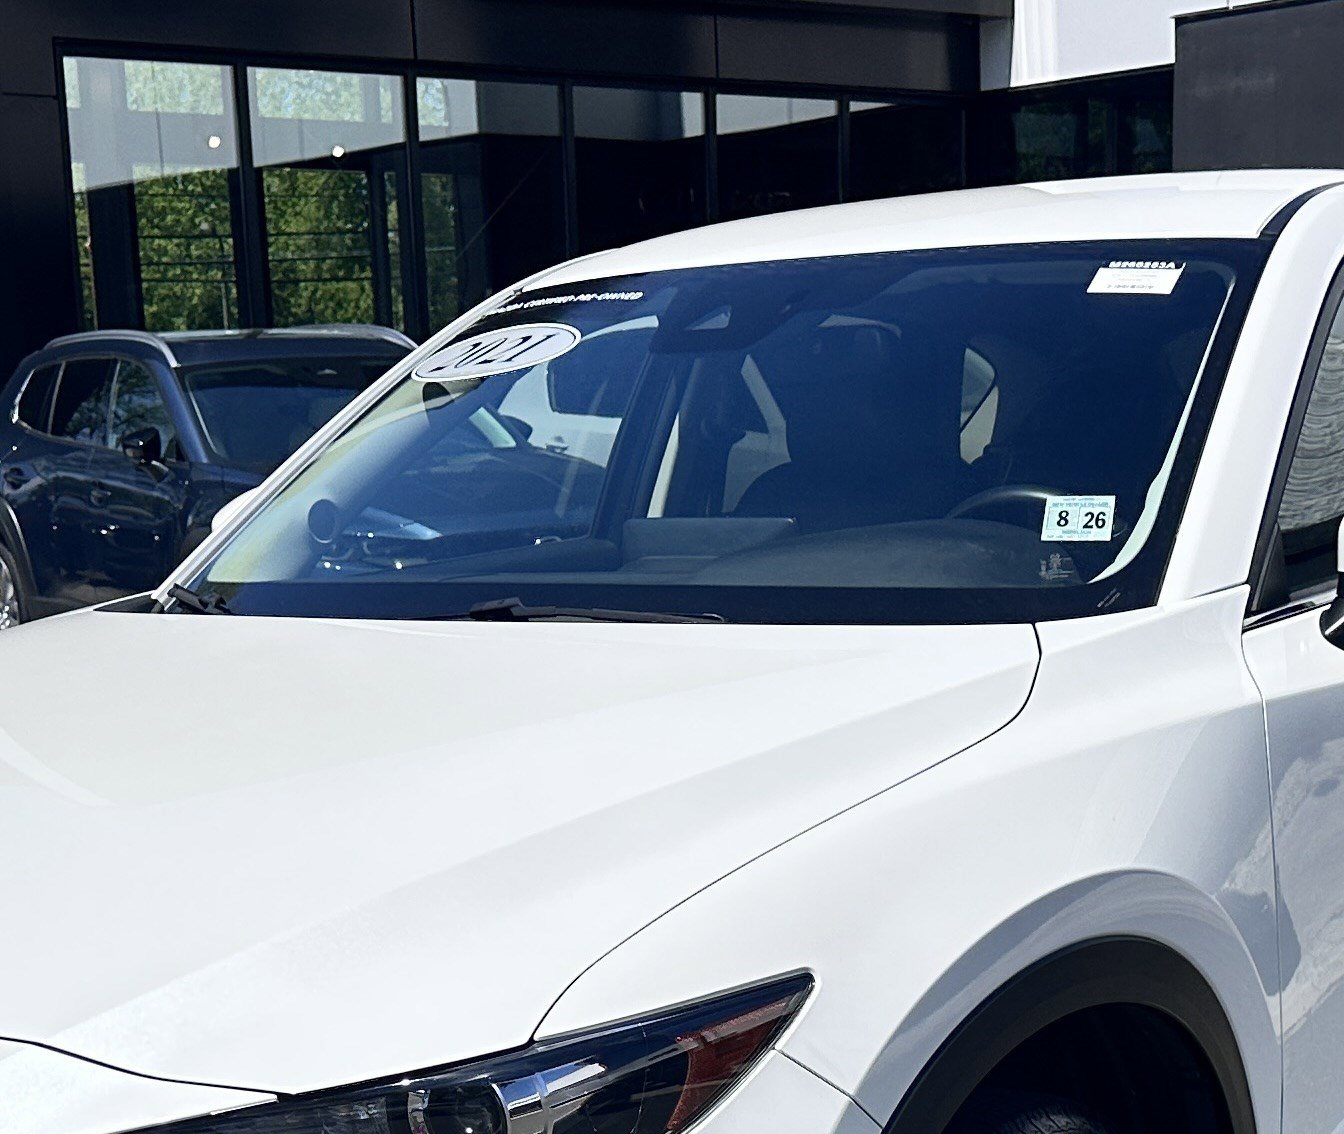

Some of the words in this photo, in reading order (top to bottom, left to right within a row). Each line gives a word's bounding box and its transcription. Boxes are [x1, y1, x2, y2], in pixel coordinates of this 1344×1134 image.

[428, 332, 560, 374] 2021
[1056, 510, 1069, 527] 8
[1082, 511, 1106, 529] 26
